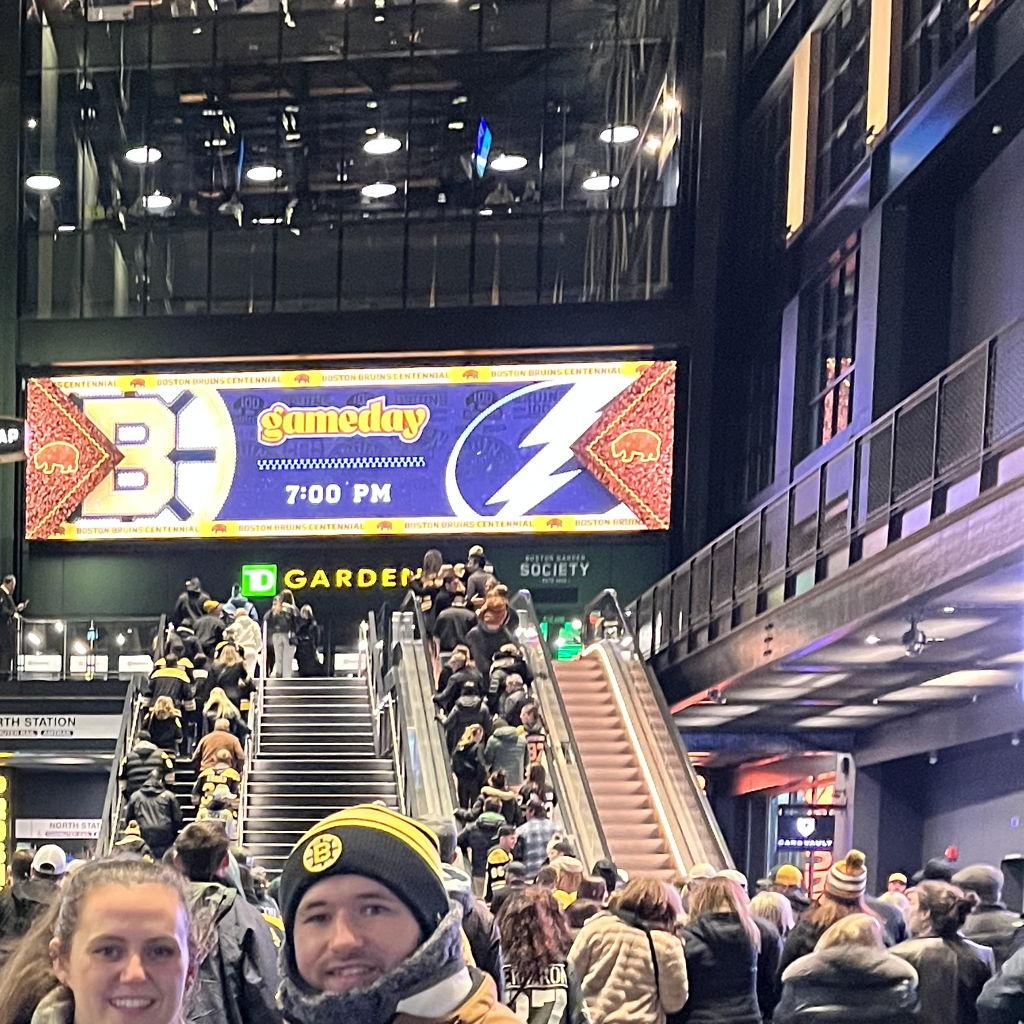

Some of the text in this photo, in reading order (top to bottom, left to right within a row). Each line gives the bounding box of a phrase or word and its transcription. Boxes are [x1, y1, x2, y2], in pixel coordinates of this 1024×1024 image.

[321, 371, 449, 382] BOSTON BRUINS CENTENNIAL
[491, 367, 622, 378] BOSTON BRUINS CENTENNIAL
[157, 378, 191, 386] BOSTON
[227, 376, 282, 385] CENTENNIAL
[260, 400, 428, 444] gameday
[285, 483, 392, 504] 7:00 PM
[239, 524, 273, 532] BOSTON
[308, 522, 364, 531] CENTENNIAL
[441, 521, 475, 529] BRUINS
[477, 520, 534, 528] CENTENNIAL
[575, 518, 643, 527] BOSTON BRUIN
[76, 525, 199, 535] BOSTON BRUINS CENTENNIAL
[520, 561, 590, 577] SOCIETY
[245, 568, 276, 590] TD
[24, 717, 76, 727] STATION
[49, 821, 79, 830] NORTH
[777, 838, 833, 848] CARD VAULT
